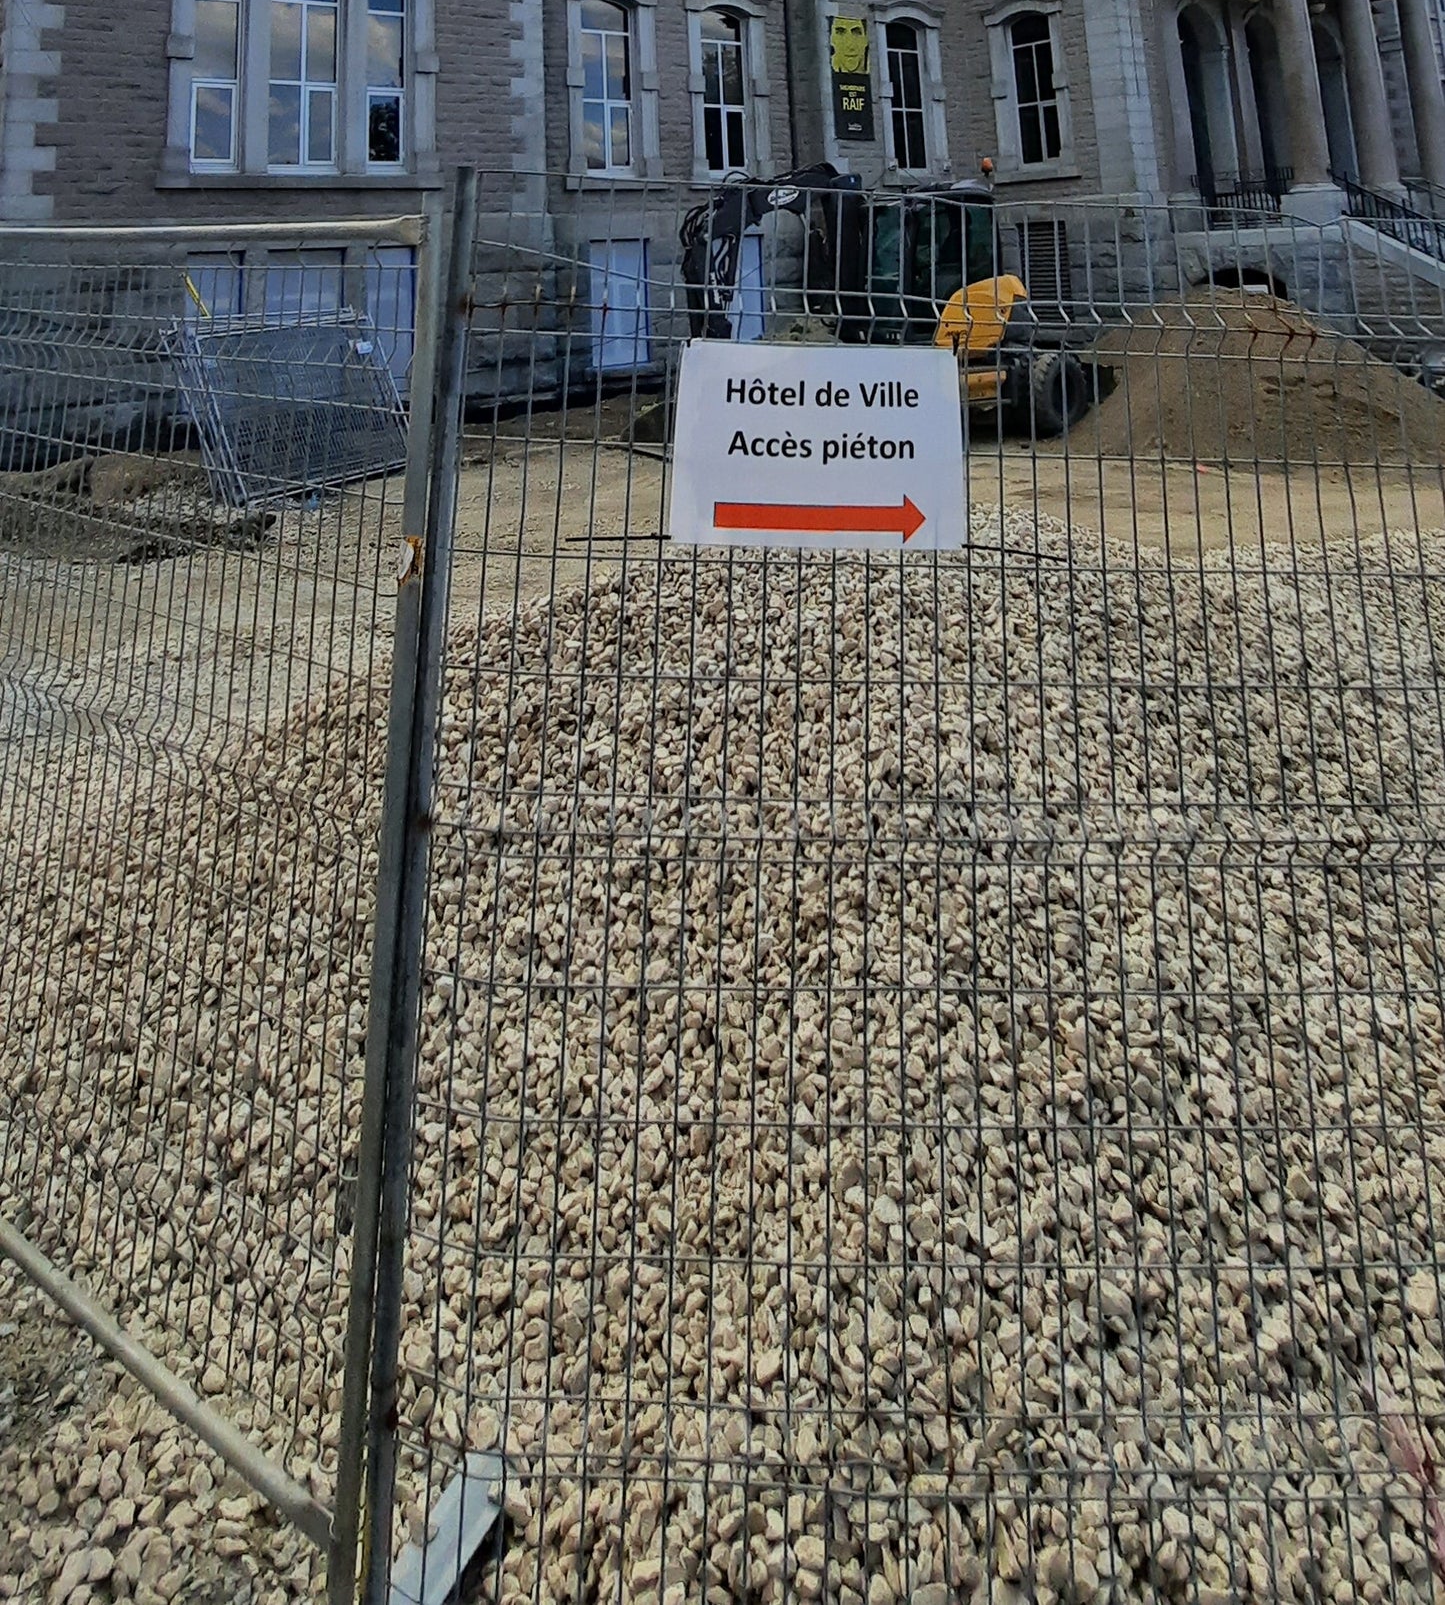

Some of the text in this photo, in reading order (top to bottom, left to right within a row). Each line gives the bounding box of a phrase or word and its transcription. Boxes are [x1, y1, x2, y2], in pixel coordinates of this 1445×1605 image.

[842, 97, 865, 111] RAIF
[726, 378, 919, 407] Hôtel de Ville
[727, 431, 915, 465] Accès piéton
